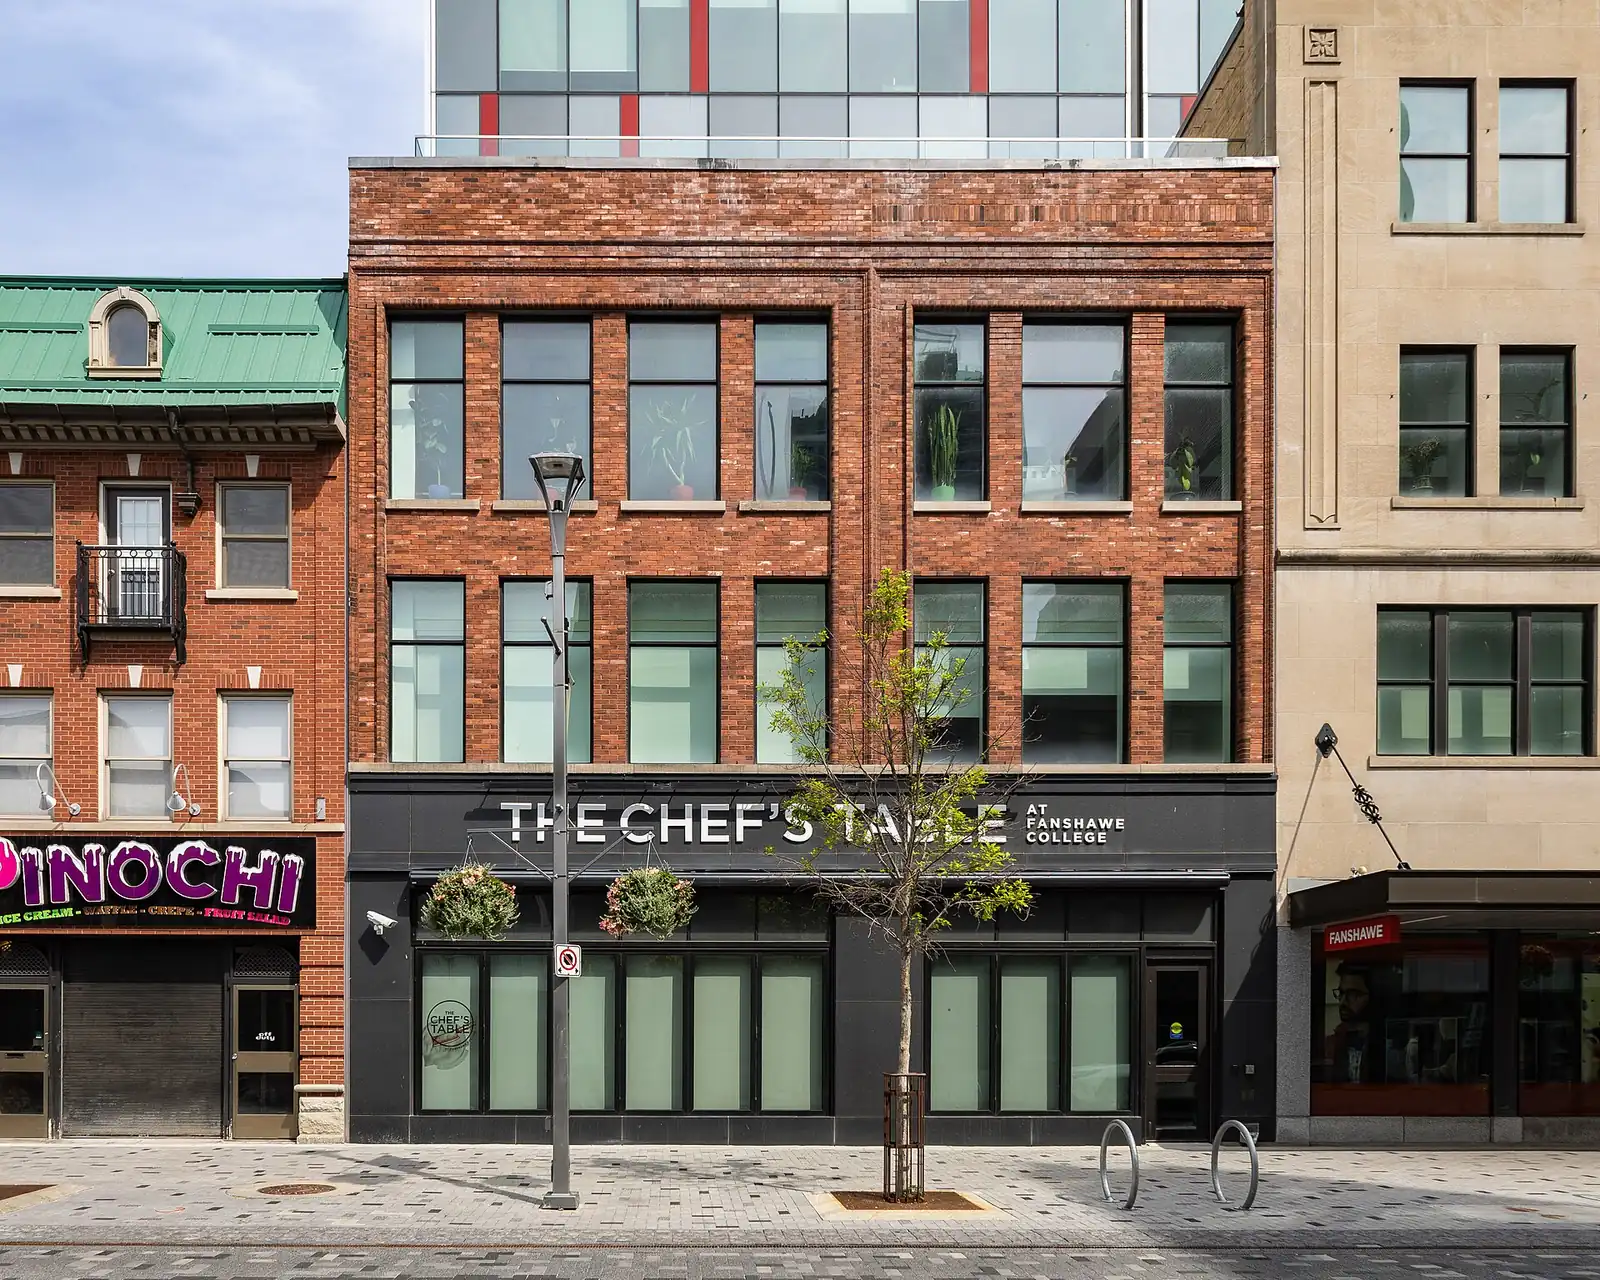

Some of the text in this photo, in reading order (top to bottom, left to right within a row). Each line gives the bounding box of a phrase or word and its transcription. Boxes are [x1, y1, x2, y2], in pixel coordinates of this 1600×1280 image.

[1026, 804, 1048, 815] AT
[500, 803, 606, 842] THE
[619, 802, 814, 843] CHEF'S
[1026, 818, 1125, 829] FANSHAWE
[1026, 832, 1107, 843] COLLEGE
[23, 908, 74, 921] CREAM
[82, 906, 138, 915] WAFFLE
[148, 906, 195, 916] CREPE
[204, 907, 245, 920] FRUIT
[247, 912, 290, 925] SALAD
[1329, 924, 1383, 945] FANSHAWE
[430, 1016, 470, 1024] CHEF'S
[431, 1025, 470, 1033] TABLE
